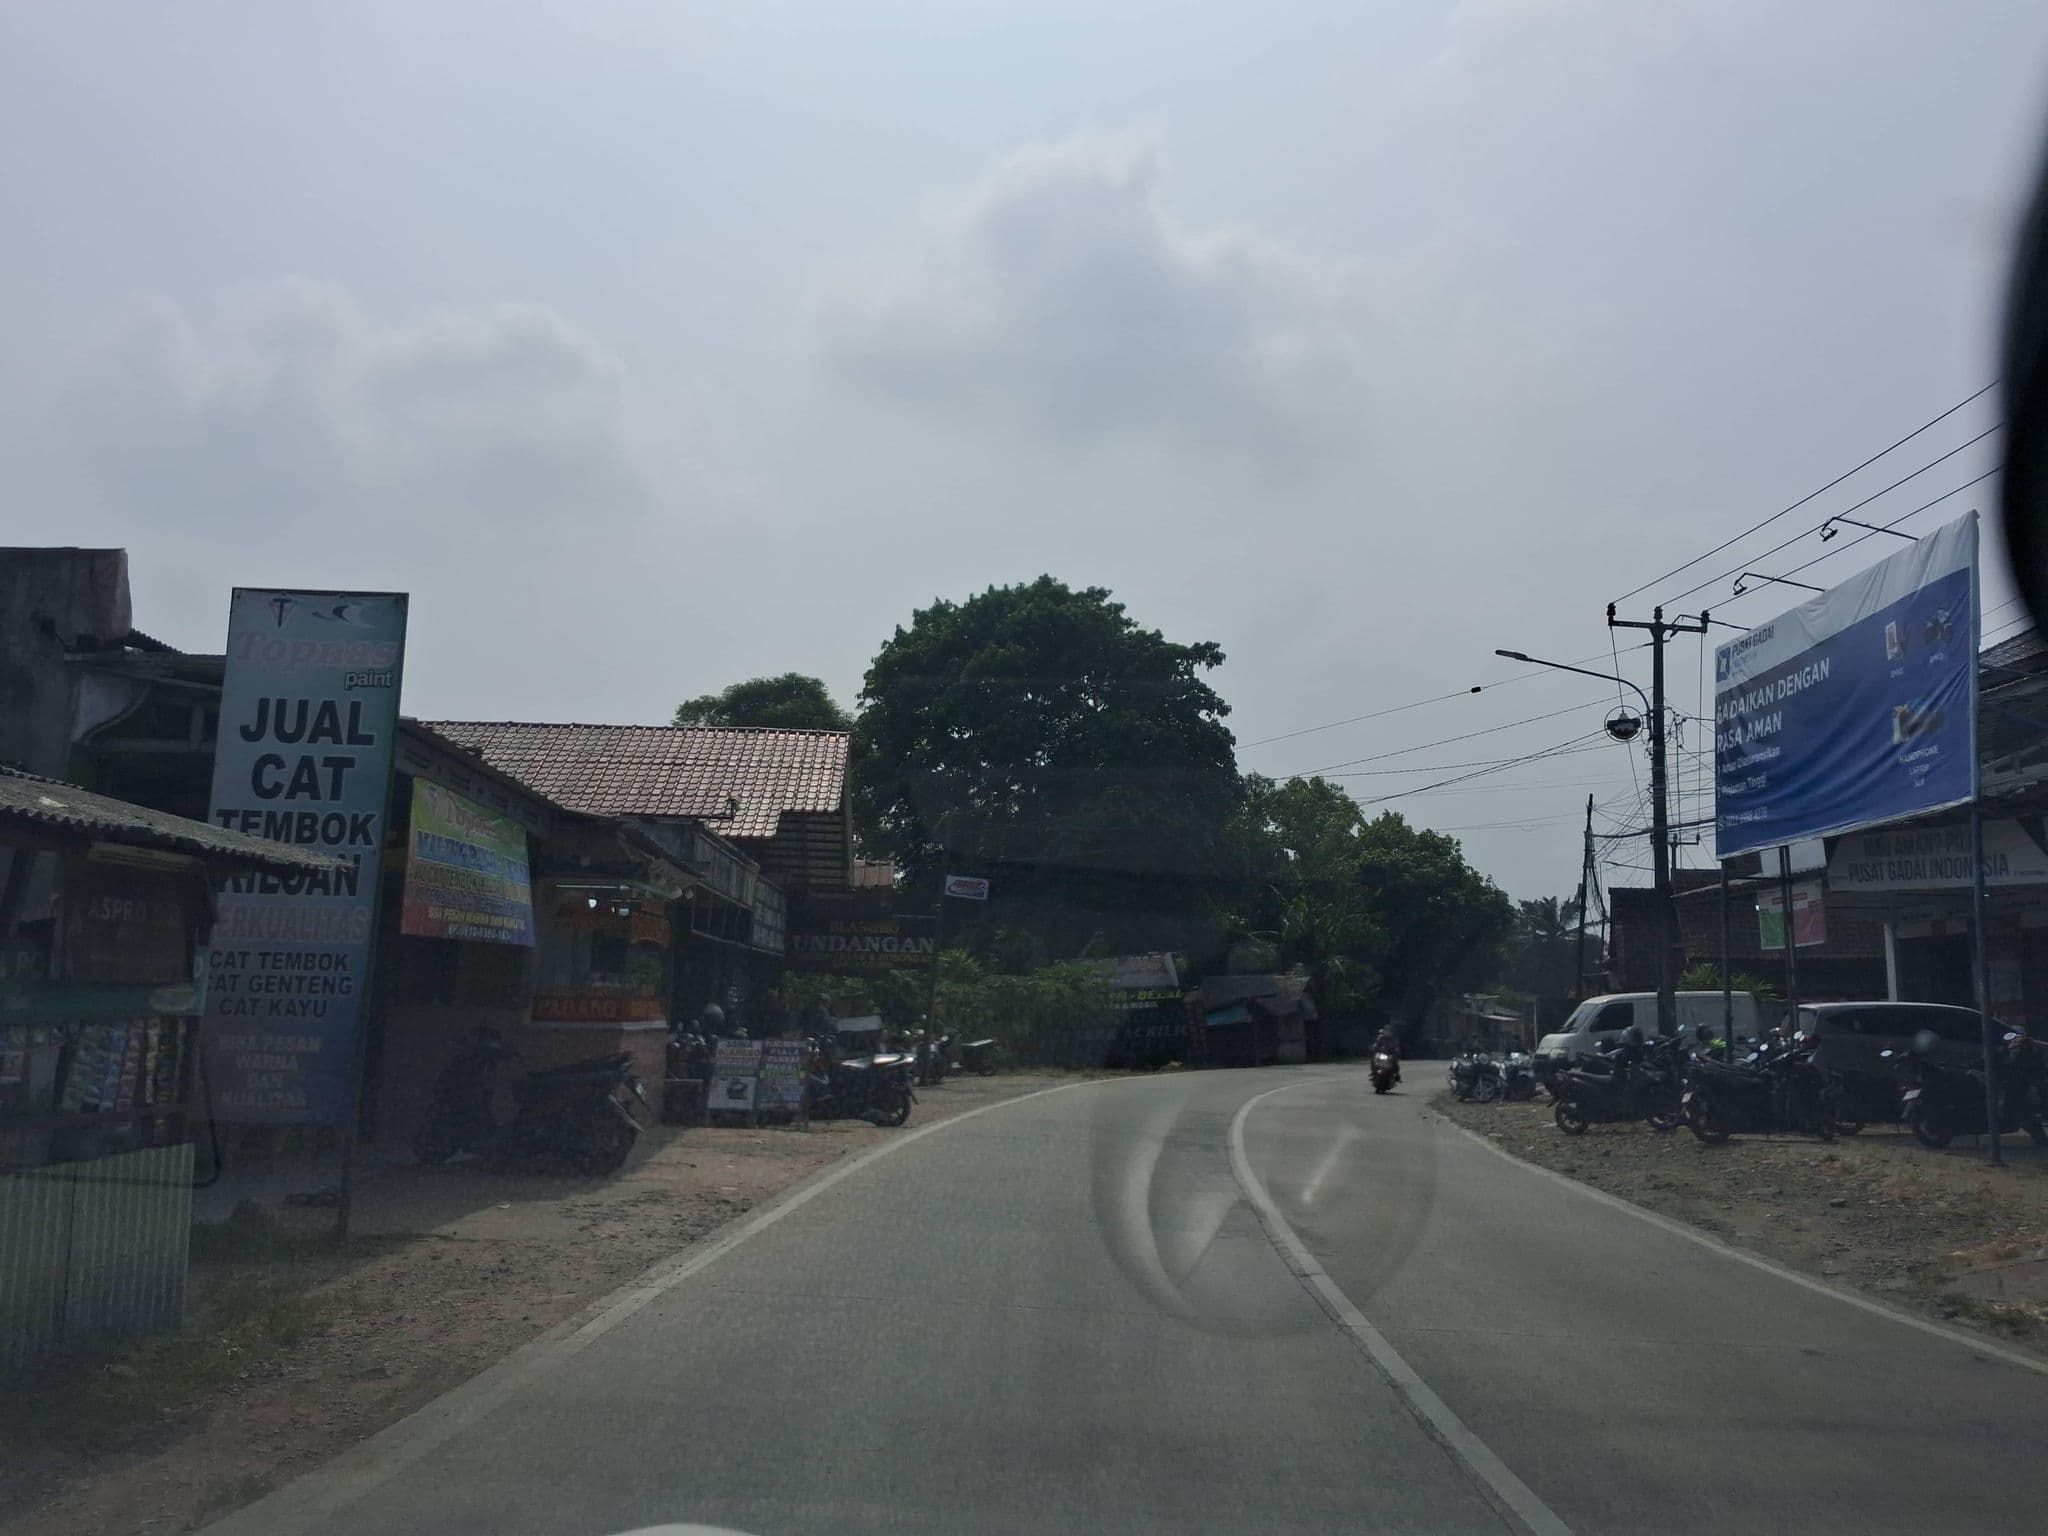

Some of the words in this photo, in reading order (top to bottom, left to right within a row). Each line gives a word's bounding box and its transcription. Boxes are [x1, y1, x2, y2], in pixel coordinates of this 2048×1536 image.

[1753, 625, 1775, 648] GADAI
[345, 669, 393, 690] paint
[1777, 657, 1830, 700] DENGAN
[240, 698, 375, 745] JUAL
[1717, 727, 1743, 754] RASA
[1745, 711, 1782, 743] AMAN
[252, 753, 356, 800] CAT
[216, 809, 377, 845] TEMBOK
[1848, 861, 1885, 883] PUSAT
[1888, 857, 1928, 881] GADAI
[1930, 853, 2009, 880] INDONSIA
[215, 904, 369, 943] ERKUALITAS
[792, 935, 936, 954] UNDANGAN
[210, 950, 251, 969] CAT
[259, 951, 349, 971] TEMBOK
[249, 975, 353, 995] GENTENG
[219, 998, 262, 1016] CAT
[268, 1000, 328, 1018] KAYU
[263, 1035, 321, 1054] PESAN
[235, 1055, 298, 1071] WARNA
